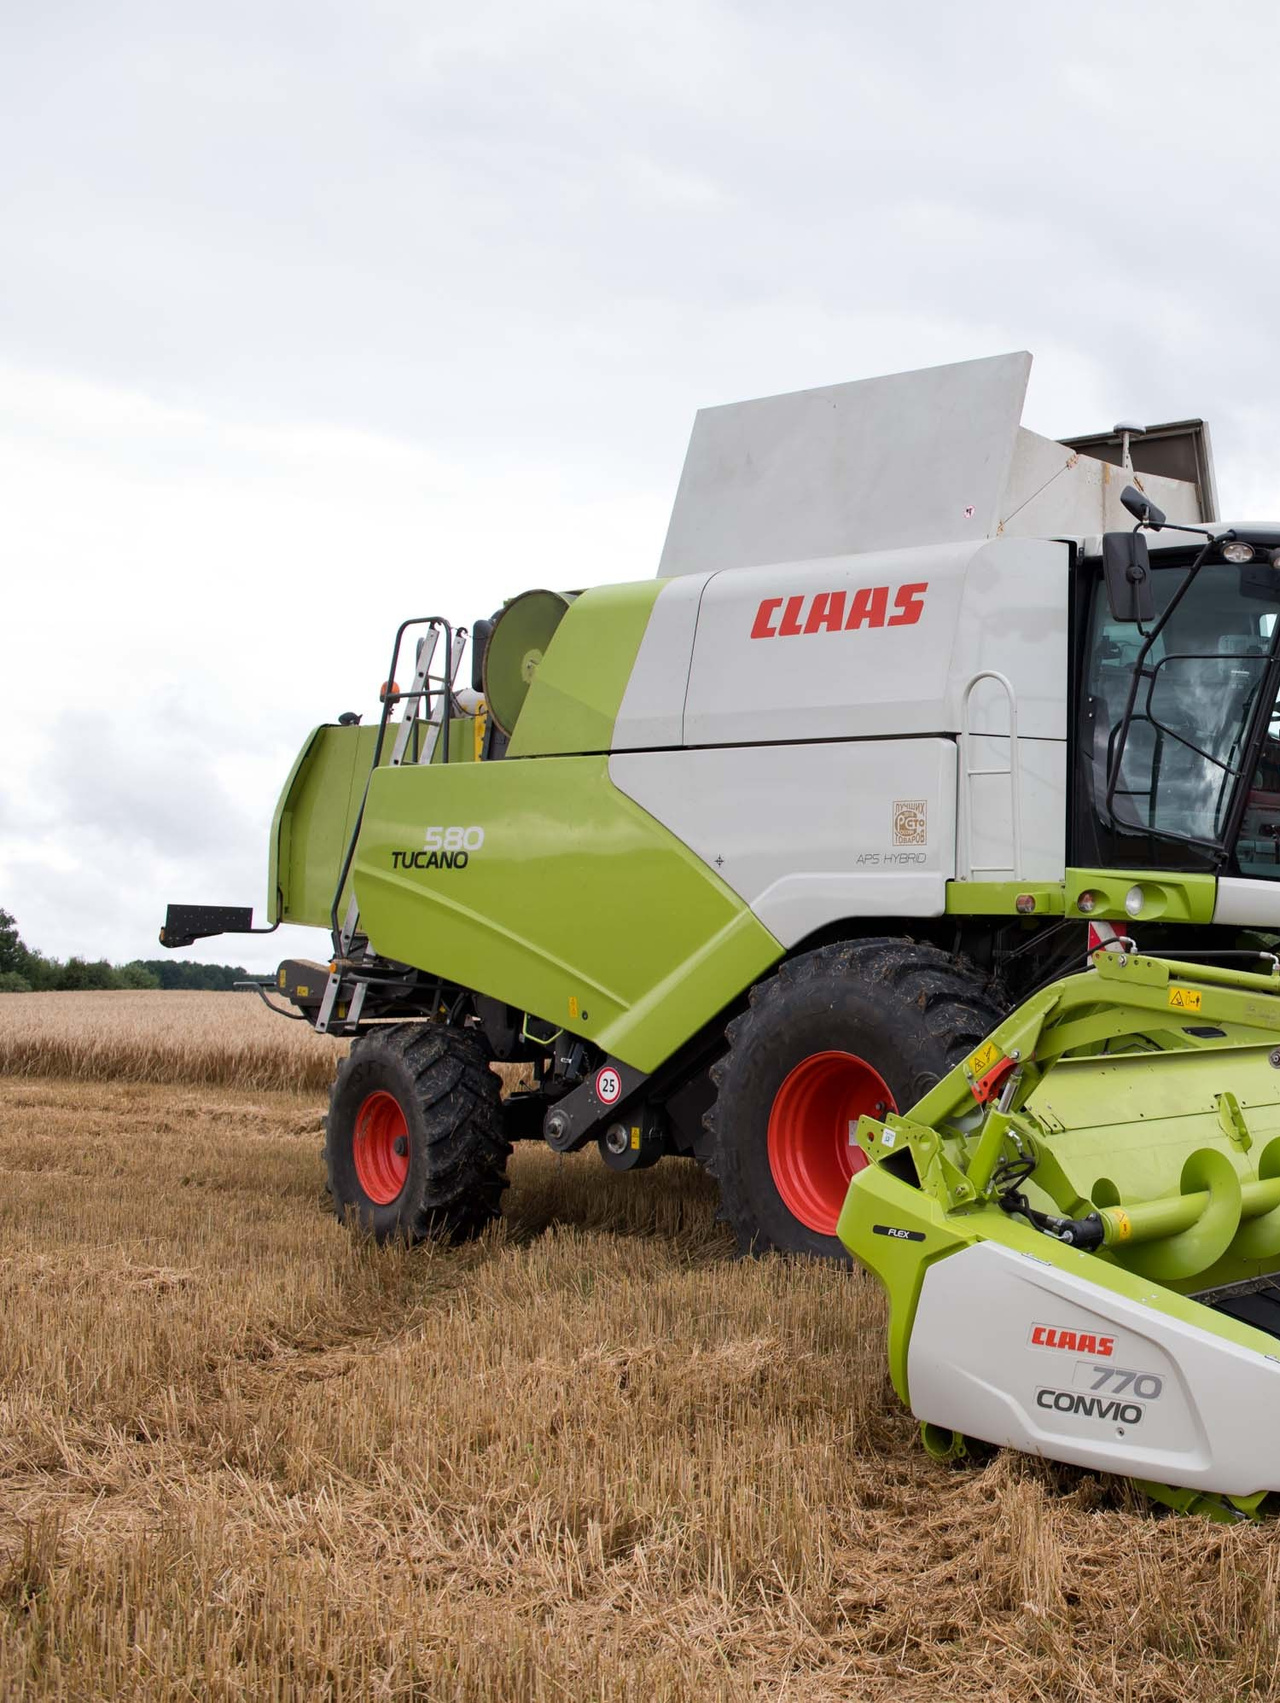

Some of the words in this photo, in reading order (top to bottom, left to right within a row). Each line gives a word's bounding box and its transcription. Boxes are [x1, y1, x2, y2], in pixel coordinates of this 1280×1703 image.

[750, 582, 929, 639] CLAAS
[423, 826, 485, 851] 580
[391, 850, 469, 869] TUCANO
[856, 853, 880, 865] APS
[884, 852, 927, 864] HYBRID
[602, 1078, 615, 1093] 25
[888, 1228, 910, 1239] FLEX
[1031, 1327, 1114, 1357] CLAAS
[1090, 1366, 1163, 1400] 770
[1036, 1389, 1143, 1425] CONVIO
